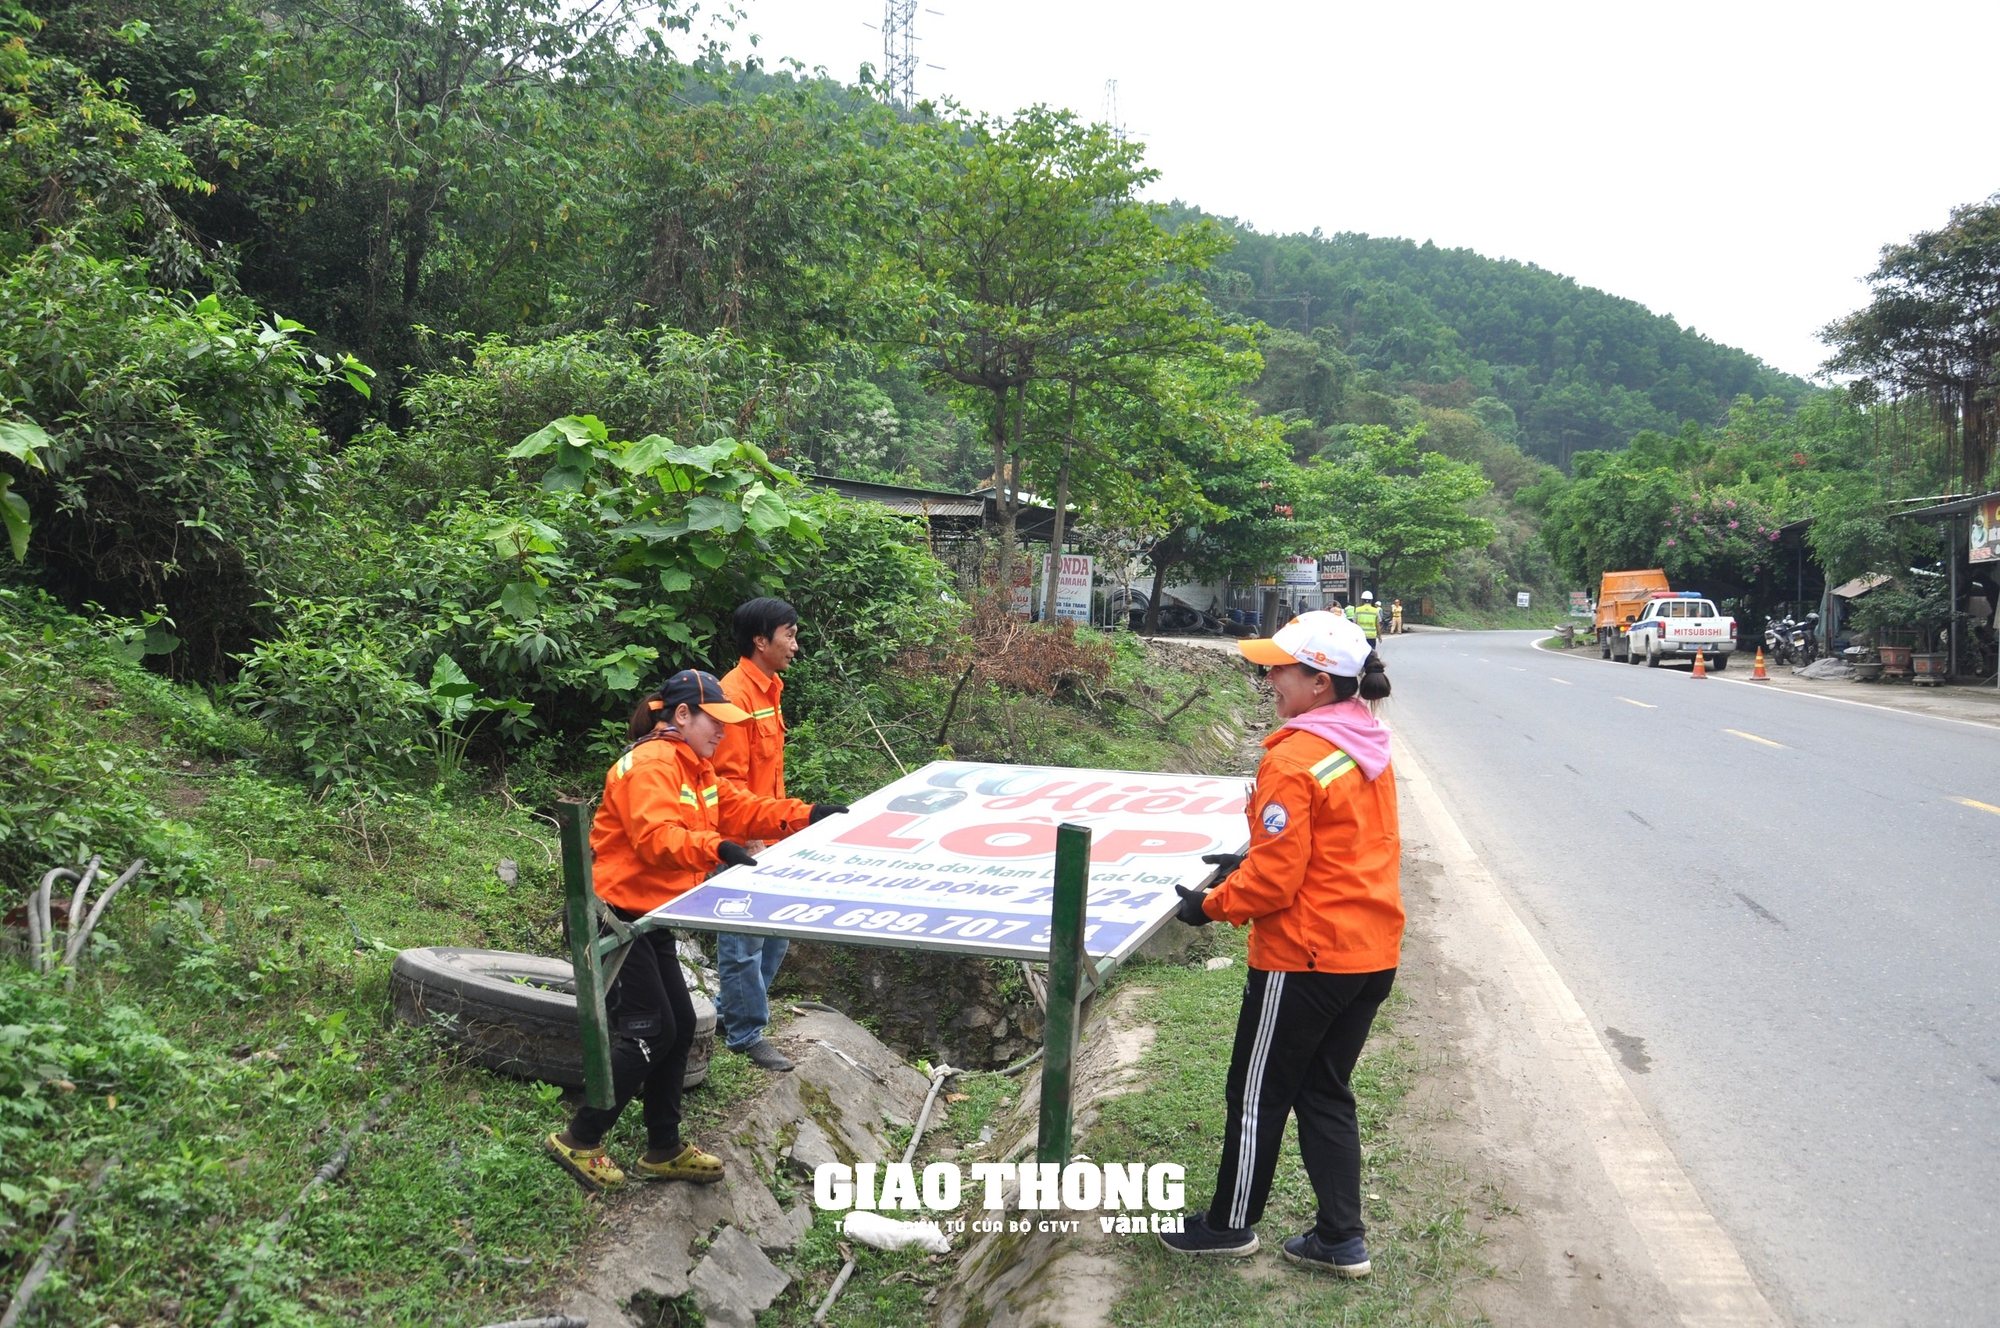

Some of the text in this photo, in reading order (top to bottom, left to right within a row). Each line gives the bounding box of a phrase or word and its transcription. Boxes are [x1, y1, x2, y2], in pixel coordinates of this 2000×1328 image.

[1674, 628, 1722, 636] MITSUBISHI
[768, 903, 835, 923] 08
[833, 908, 1031, 940] 699.707
